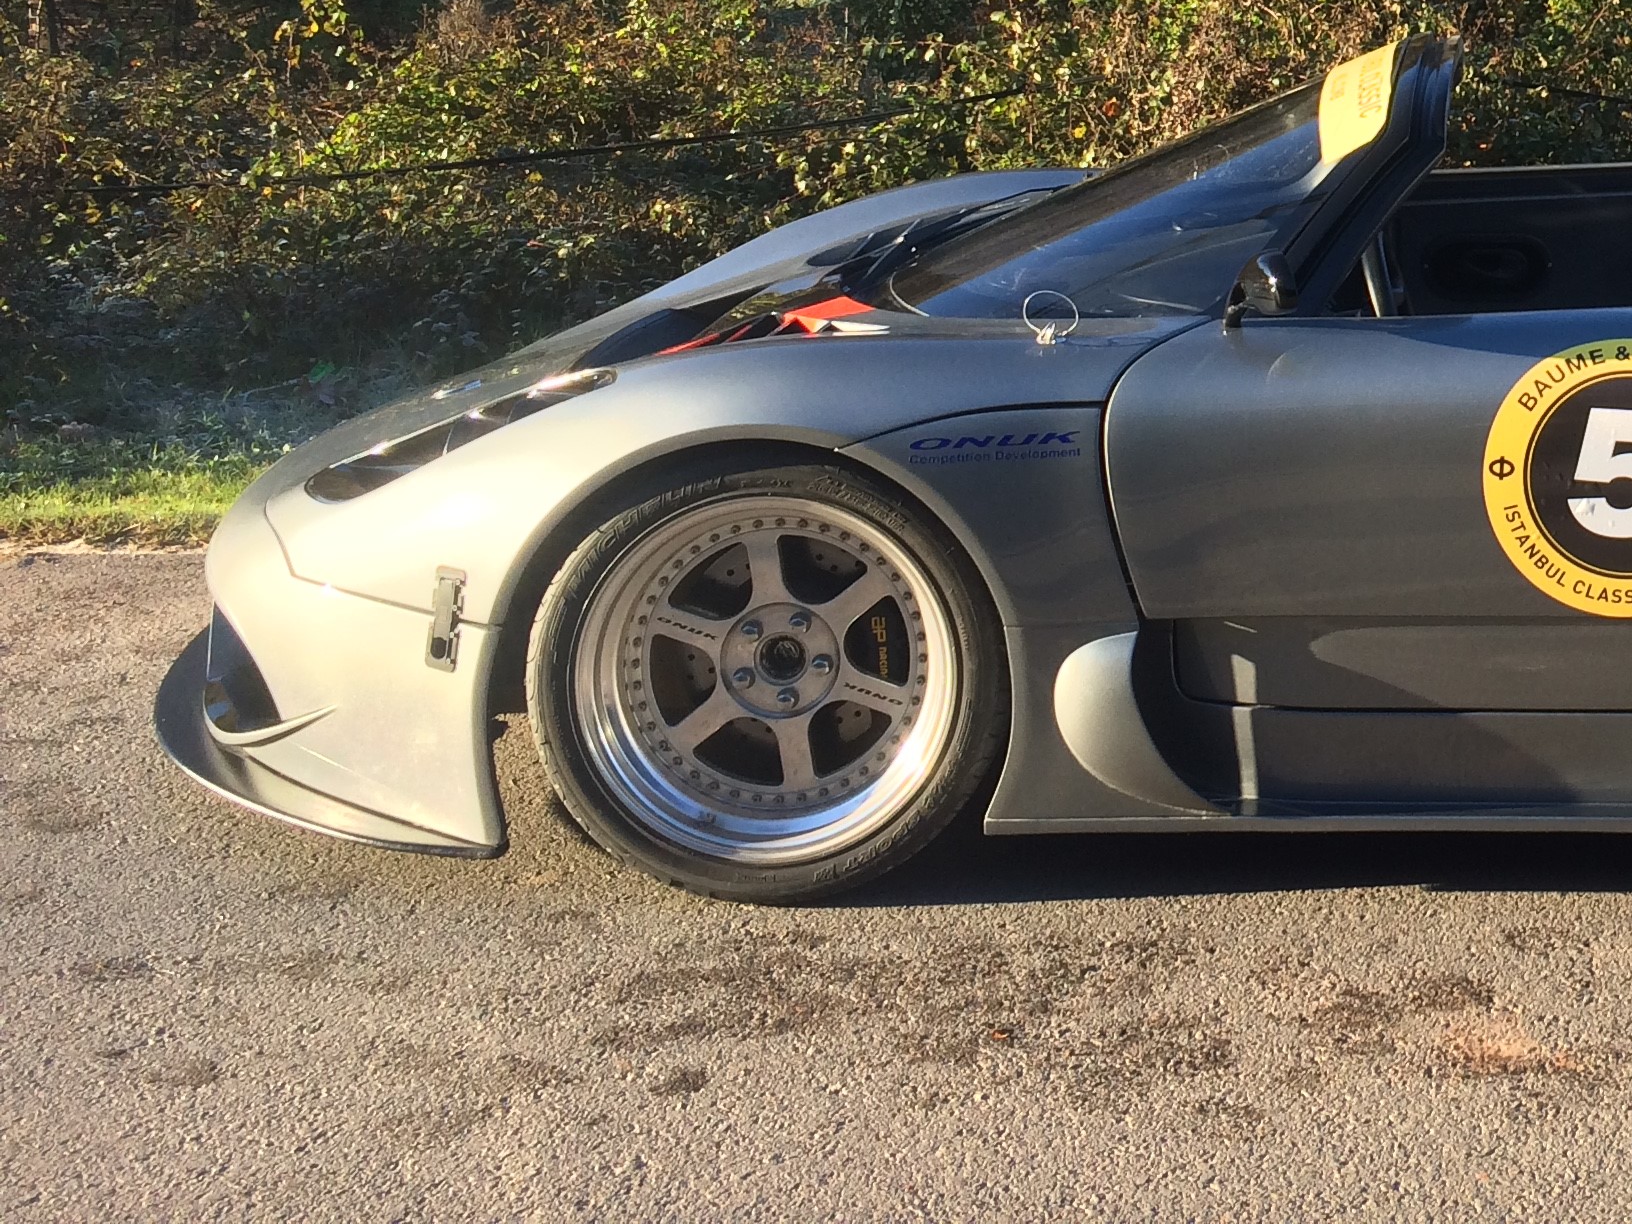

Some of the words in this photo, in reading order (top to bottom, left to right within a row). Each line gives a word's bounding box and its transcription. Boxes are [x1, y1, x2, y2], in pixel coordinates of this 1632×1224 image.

[1517, 348, 1605, 412] BAUME
[1615, 345, 1630, 361] &
[909, 430, 1081, 450] ONUK
[909, 451, 990, 465] Competition
[995, 447, 1081, 461] Development
[1503, 504, 1566, 588] ISTANBUL
[656, 616, 718, 641] ONUK
[843, 681, 904, 706] ONUK
